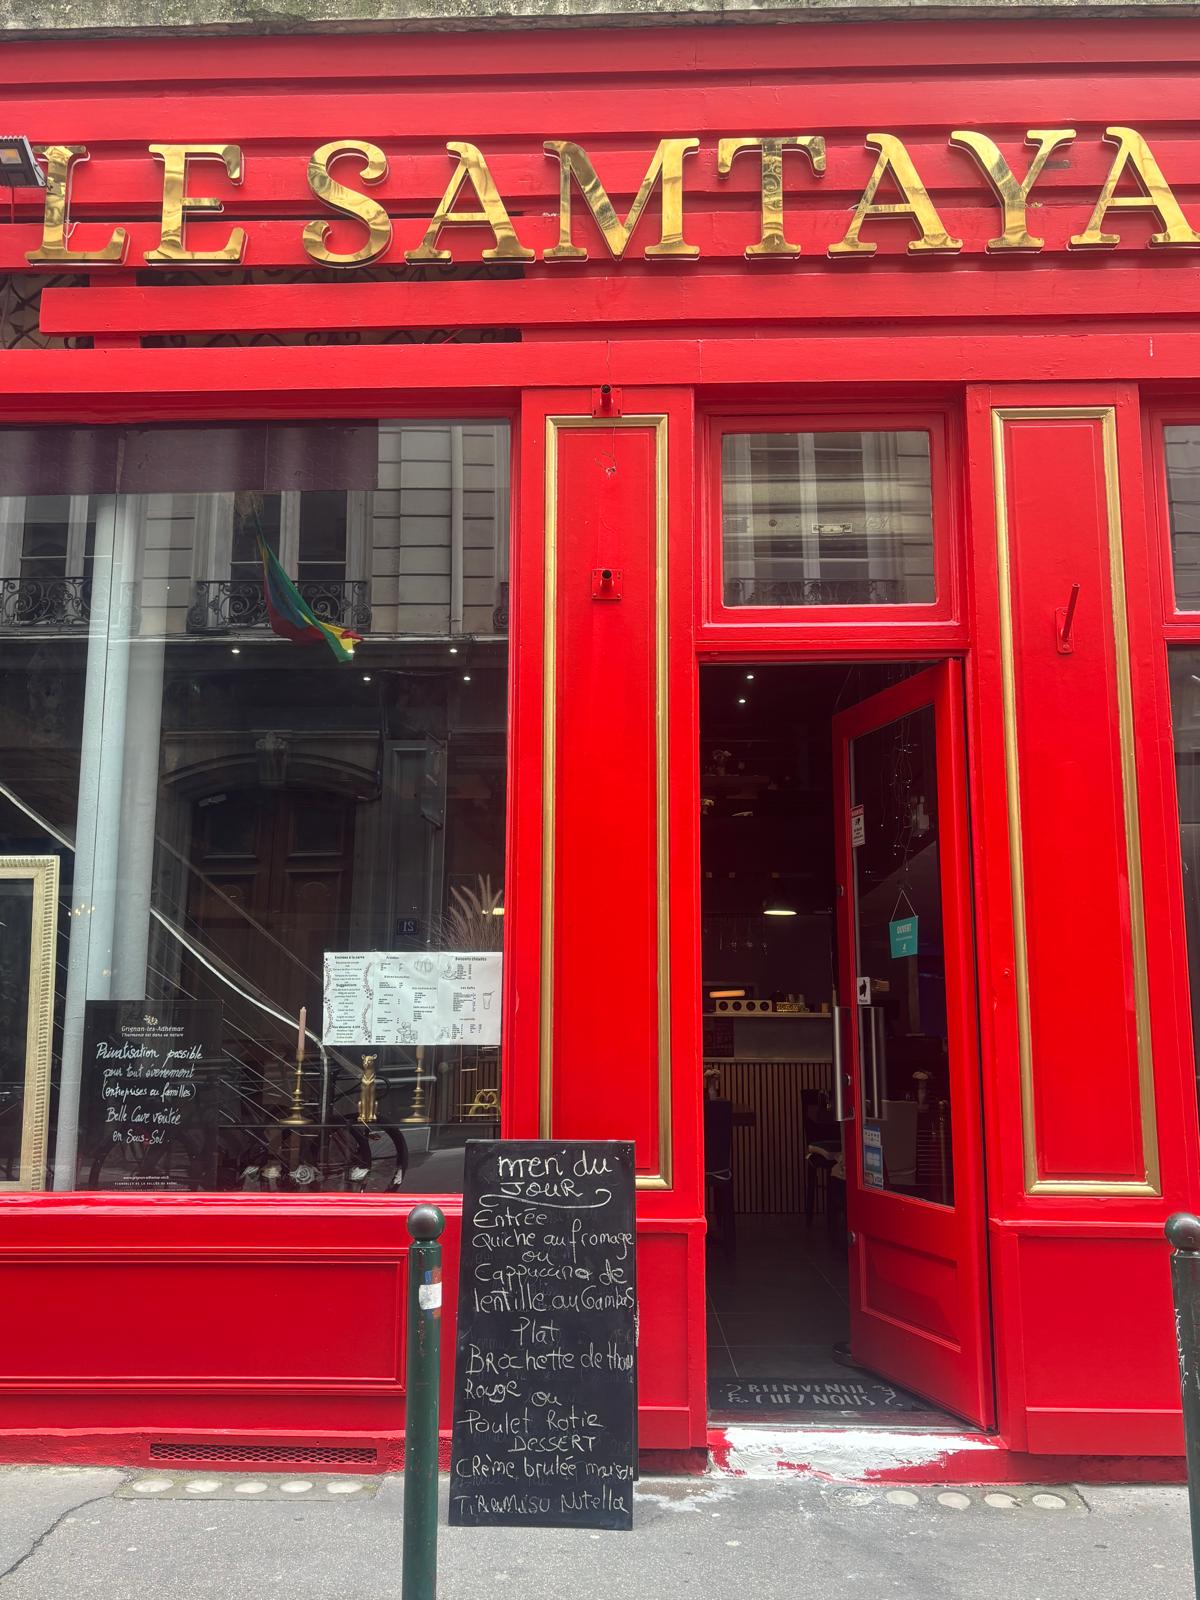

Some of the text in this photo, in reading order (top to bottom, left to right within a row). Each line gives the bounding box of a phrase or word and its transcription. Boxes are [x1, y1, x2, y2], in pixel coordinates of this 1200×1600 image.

[126, 1063, 144, 1078] tout
[149, 1088, 160, 1096] ou
[105, 1104, 127, 1123] Belle
[130, 1105, 150, 1124] Cave
[573, 1150, 612, 1177] du
[472, 1206, 548, 1228] Entrée
[472, 1219, 635, 1264] Quiche au fromage
[521, 1250, 554, 1265] ou
[598, 1259, 627, 1285] de
[474, 1282, 546, 1313] lentille
[552, 1294, 580, 1312] au
[511, 1316, 559, 1346] Plat
[580, 1342, 603, 1369] de
[464, 1378, 521, 1403] Rouge
[456, 1407, 532, 1434] Poulet
